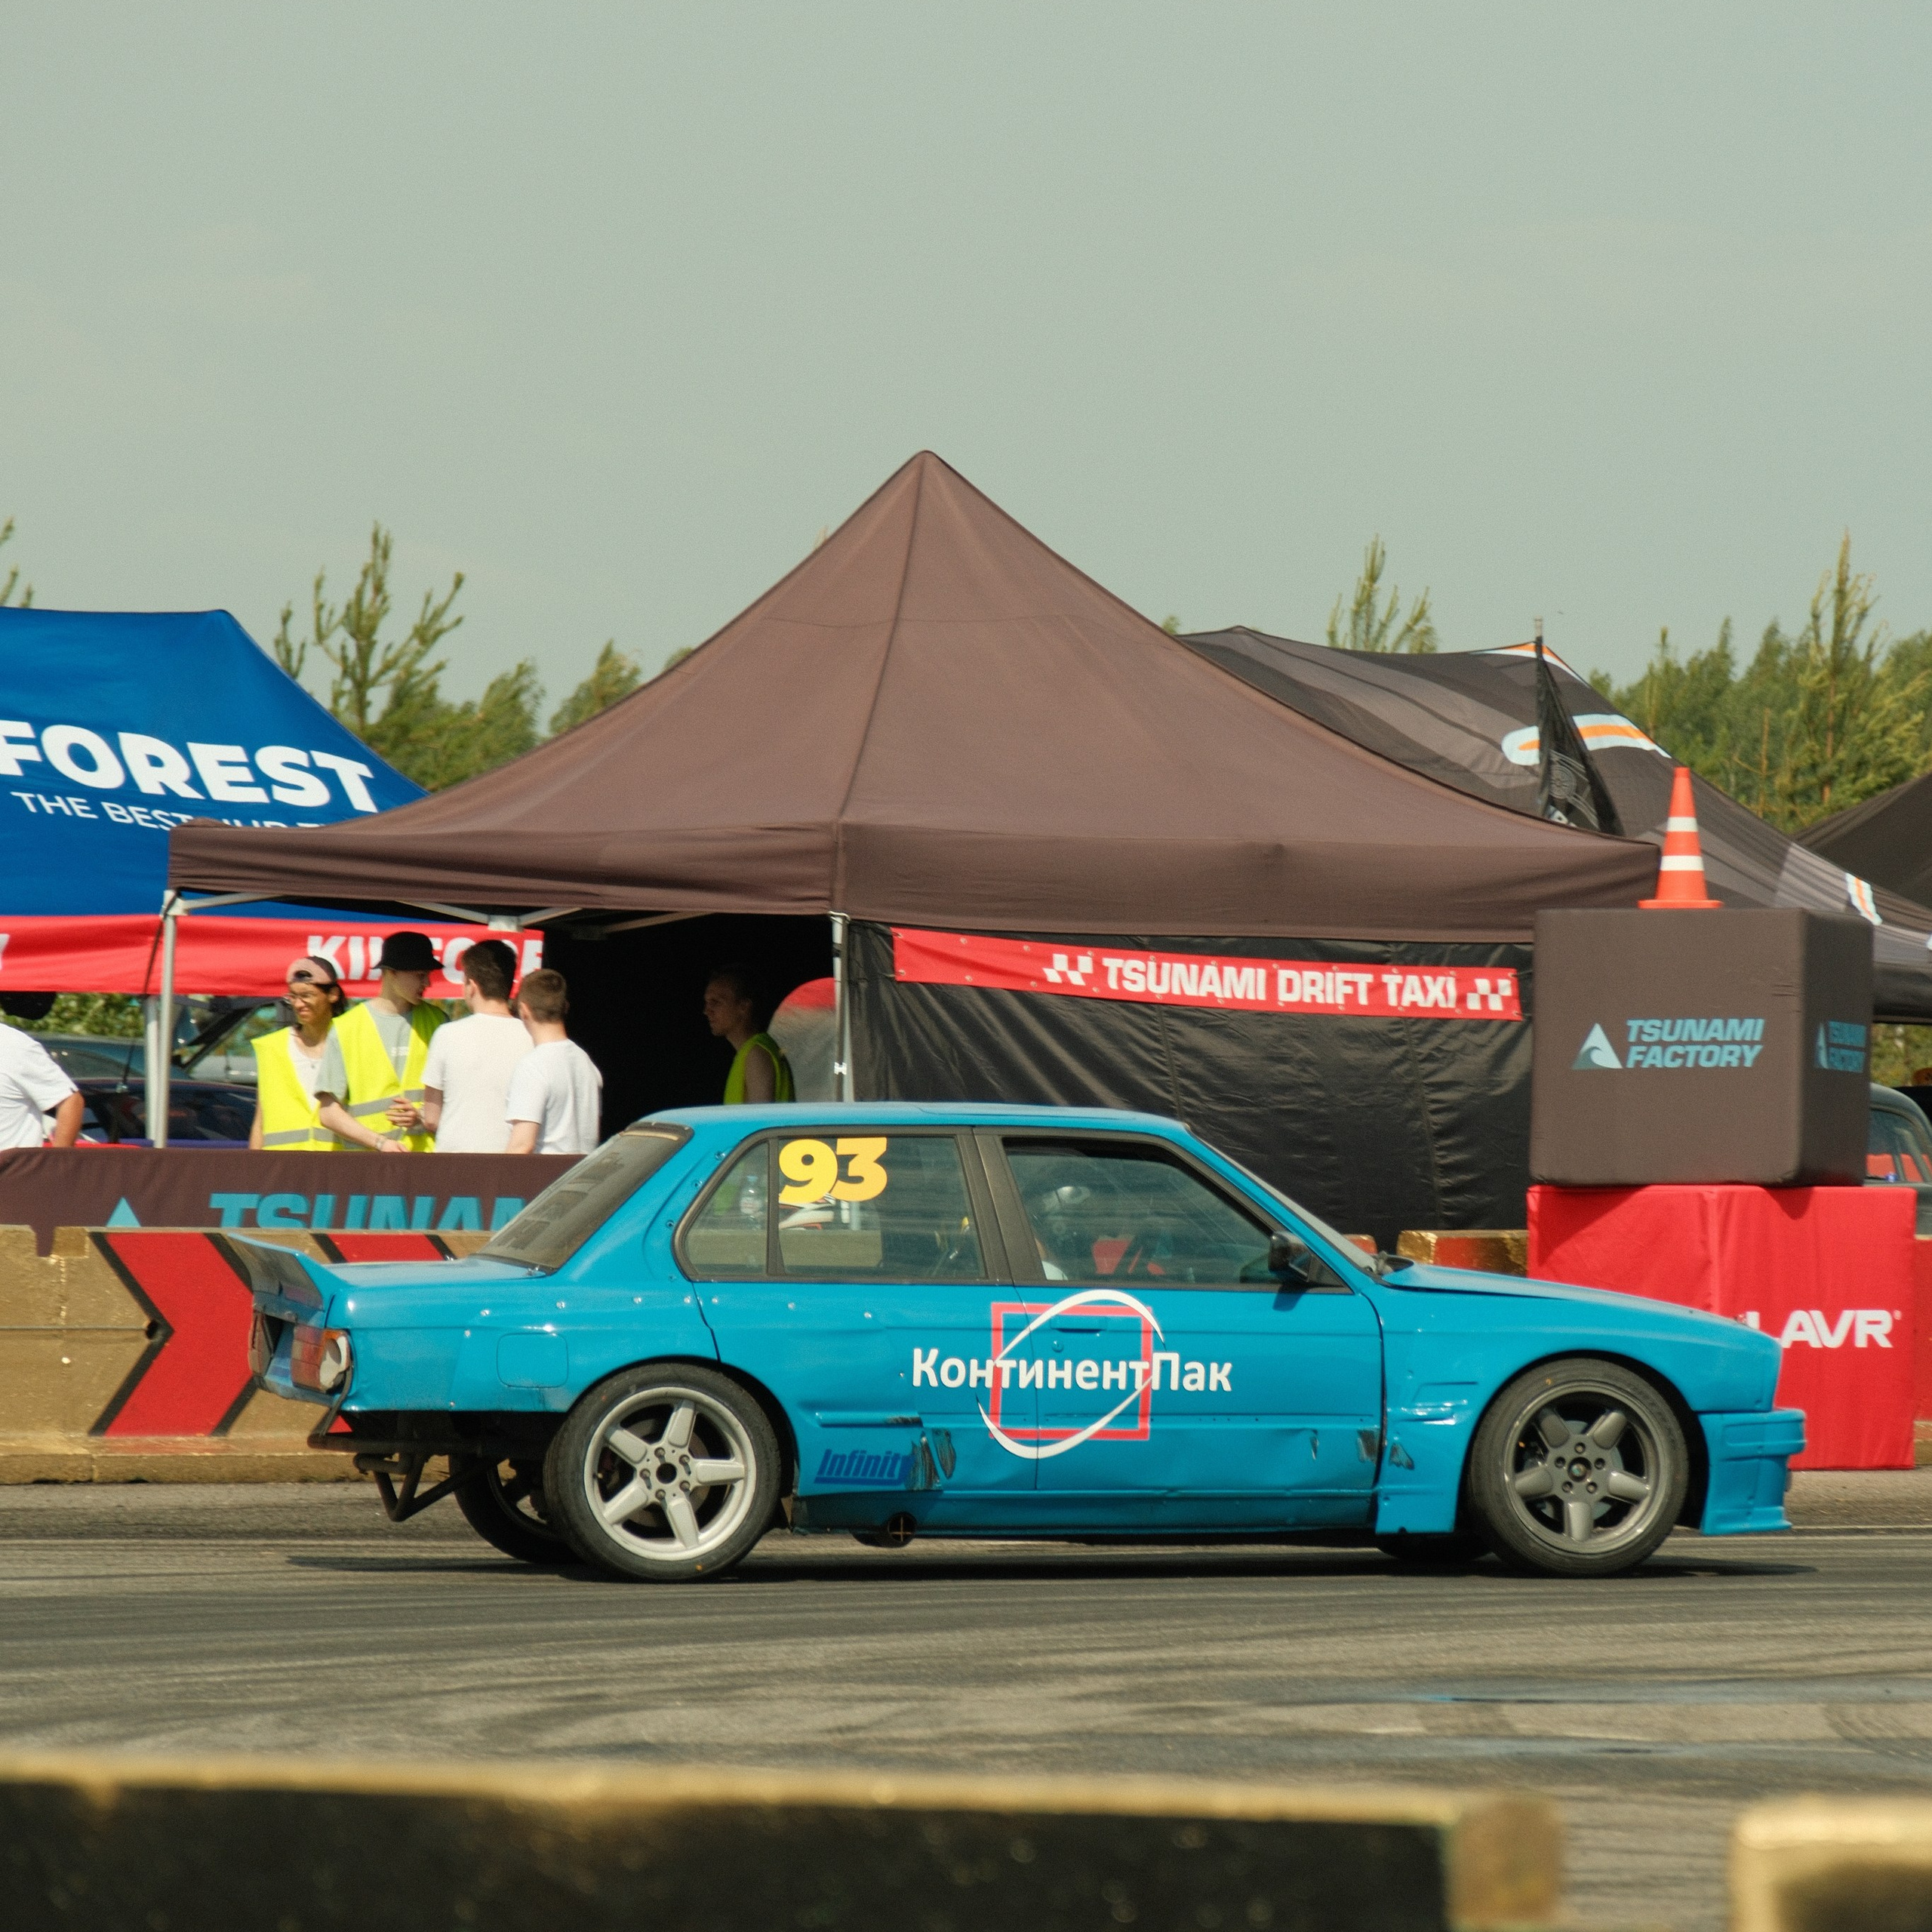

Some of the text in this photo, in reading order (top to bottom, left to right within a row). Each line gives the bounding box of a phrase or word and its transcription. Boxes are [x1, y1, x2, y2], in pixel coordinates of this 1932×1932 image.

[0, 720, 378, 813] FOREST
[11, 792, 97, 819] THE
[1103, 958, 1457, 1008] TSUNAMI DRIFT TAXI
[1626, 1018, 1765, 1042] TSUNAMI
[1626, 1044, 1764, 1069] FACTORY
[779, 1137, 888, 1203] 93
[912, 1348, 1233, 1392] КонтинентПак
